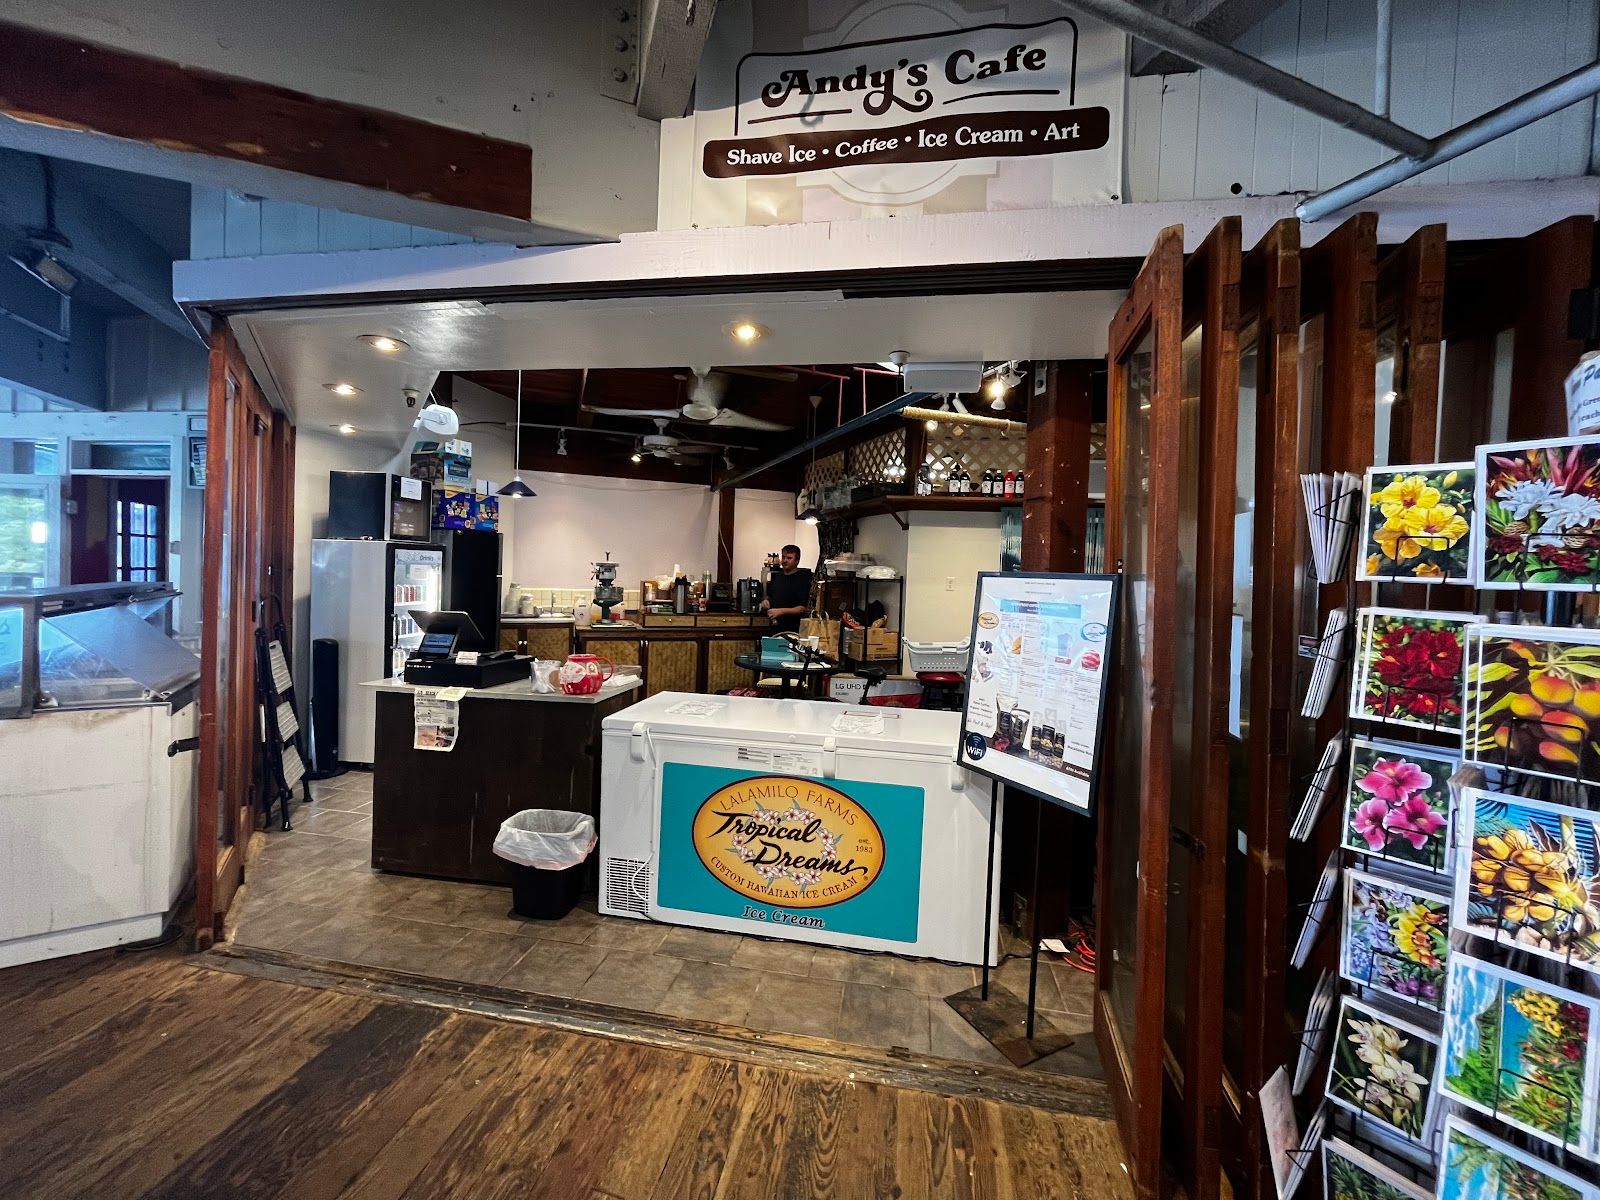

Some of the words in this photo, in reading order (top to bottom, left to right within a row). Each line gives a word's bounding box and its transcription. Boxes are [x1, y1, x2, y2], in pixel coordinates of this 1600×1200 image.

[761, 59, 933, 116] Andy's
[944, 43, 1048, 86] Cafe
[726, 146, 783, 167] Shave
[788, 145, 816, 163] Ice
[835, 137, 899, 159] Coffee
[918, 129, 948, 148] Ice
[955, 125, 1023, 146] Cream
[1043, 122, 1081, 142] Art
[720, 785, 799, 811] LALAMILO
[806, 790, 859, 826] FARMS
[706, 810, 822, 844] Tropical
[711, 856, 745, 886] CUSTOM
[746, 881, 799, 899] HAWAIIAN
[801, 890, 820, 899] ICE
[822, 876, 858, 897] CREAM
[744, 839, 869, 876] Dreams
[742, 905, 767, 921] Ice
[772, 910, 825, 928] Cream
